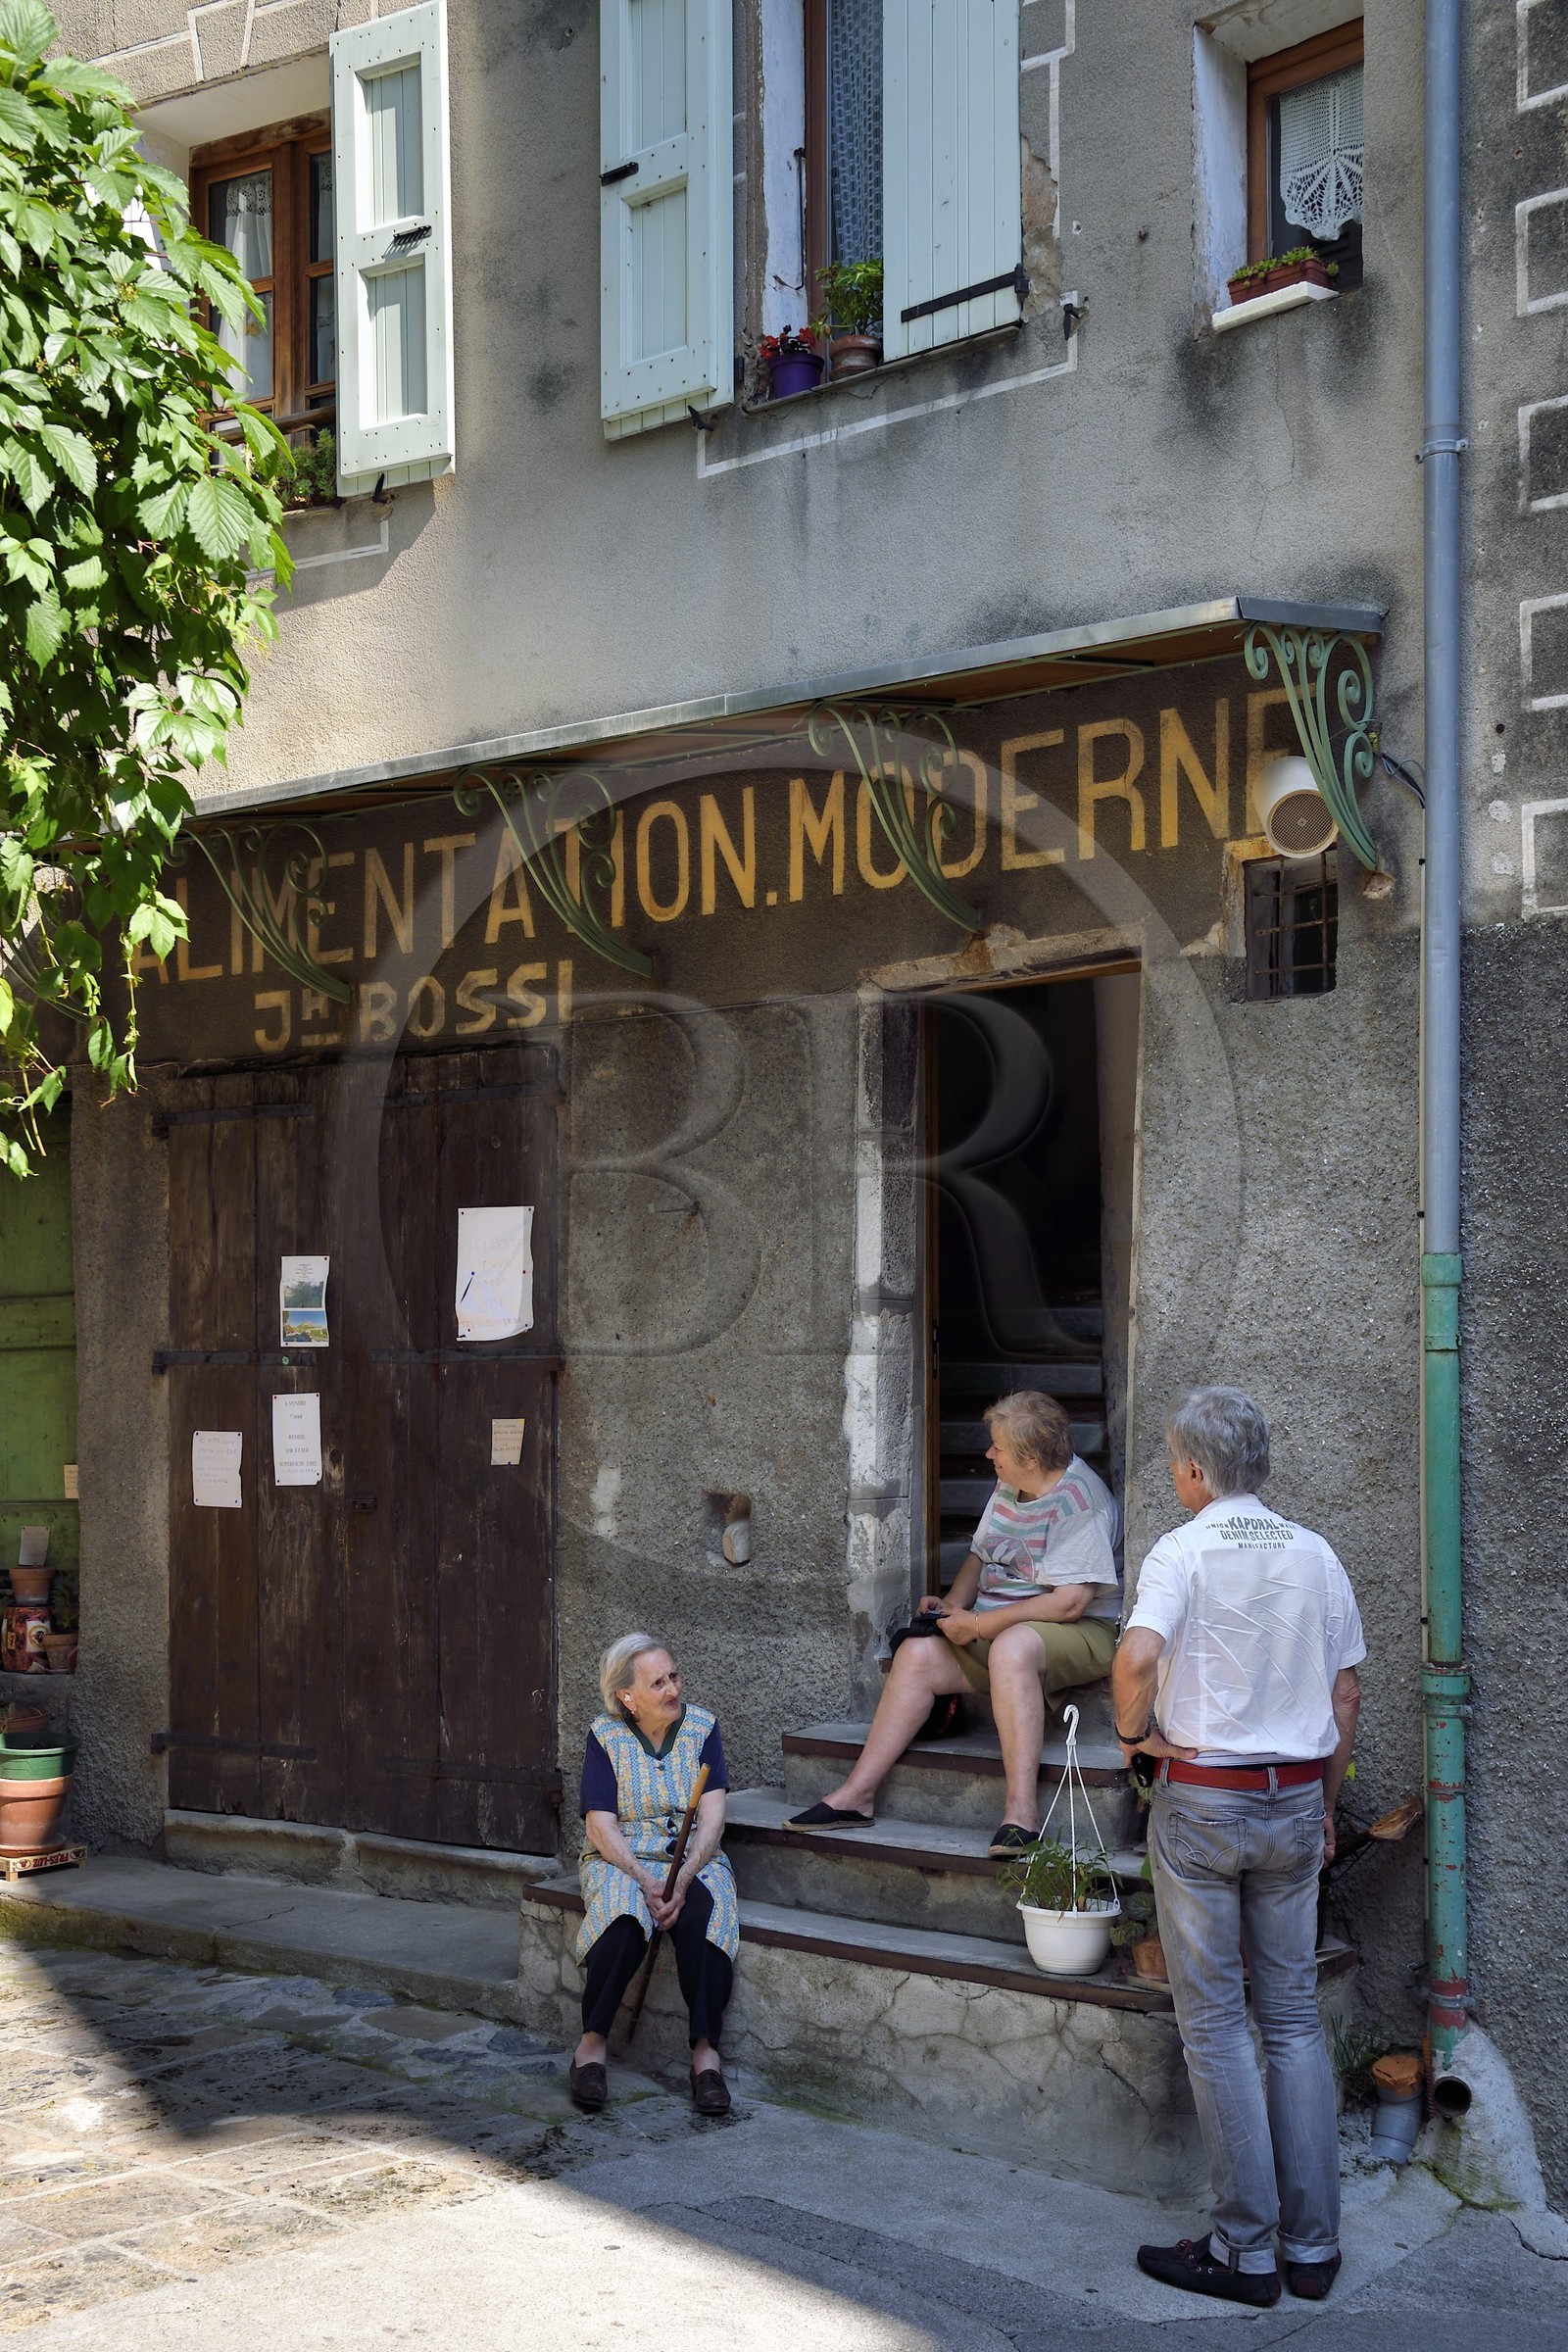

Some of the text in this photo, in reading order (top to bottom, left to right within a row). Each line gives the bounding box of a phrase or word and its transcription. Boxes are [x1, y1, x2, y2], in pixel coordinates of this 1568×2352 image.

[360, 959, 573, 1043] BOSSI
[1227, 1516, 1280, 1531] KAPORAL
[1219, 1530, 1294, 1542] DENIM SELECTED
